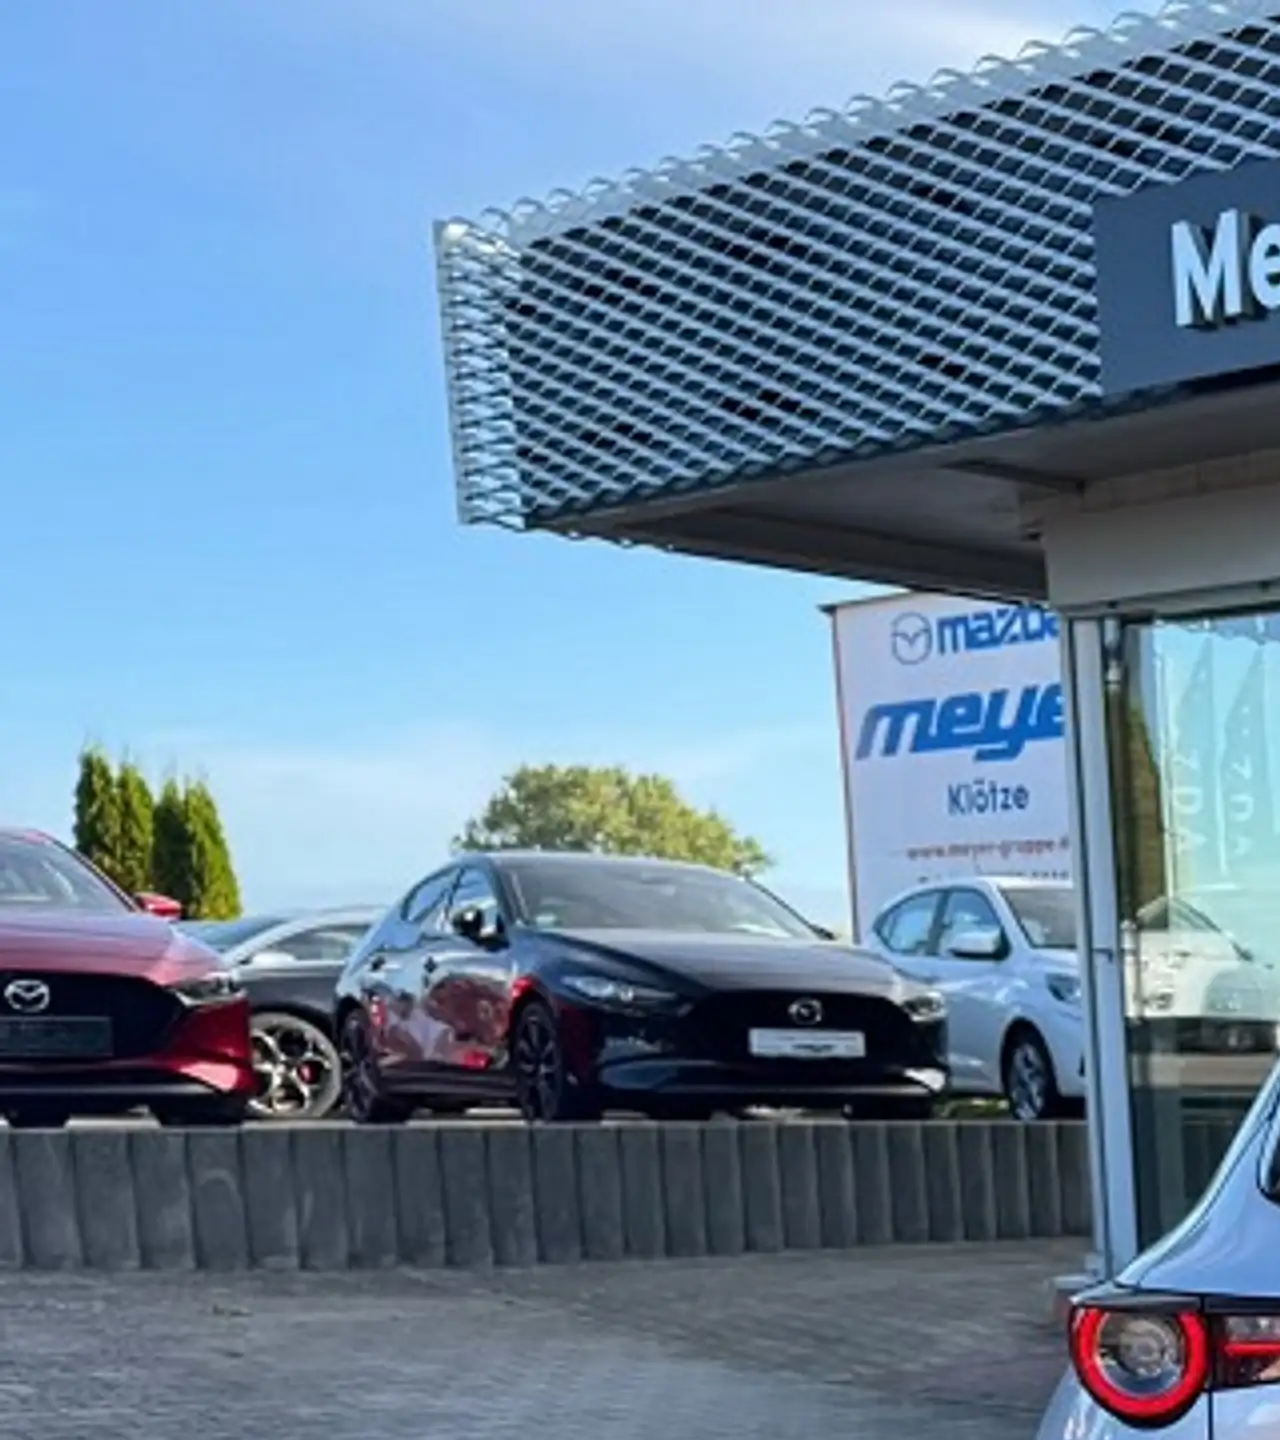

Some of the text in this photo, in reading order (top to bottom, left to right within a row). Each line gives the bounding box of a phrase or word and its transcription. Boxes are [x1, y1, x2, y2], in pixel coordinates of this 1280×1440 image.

[936, 606, 1060, 654] mazd
[855, 683, 1065, 762] meye
[947, 778, 1029, 816] Klötze
